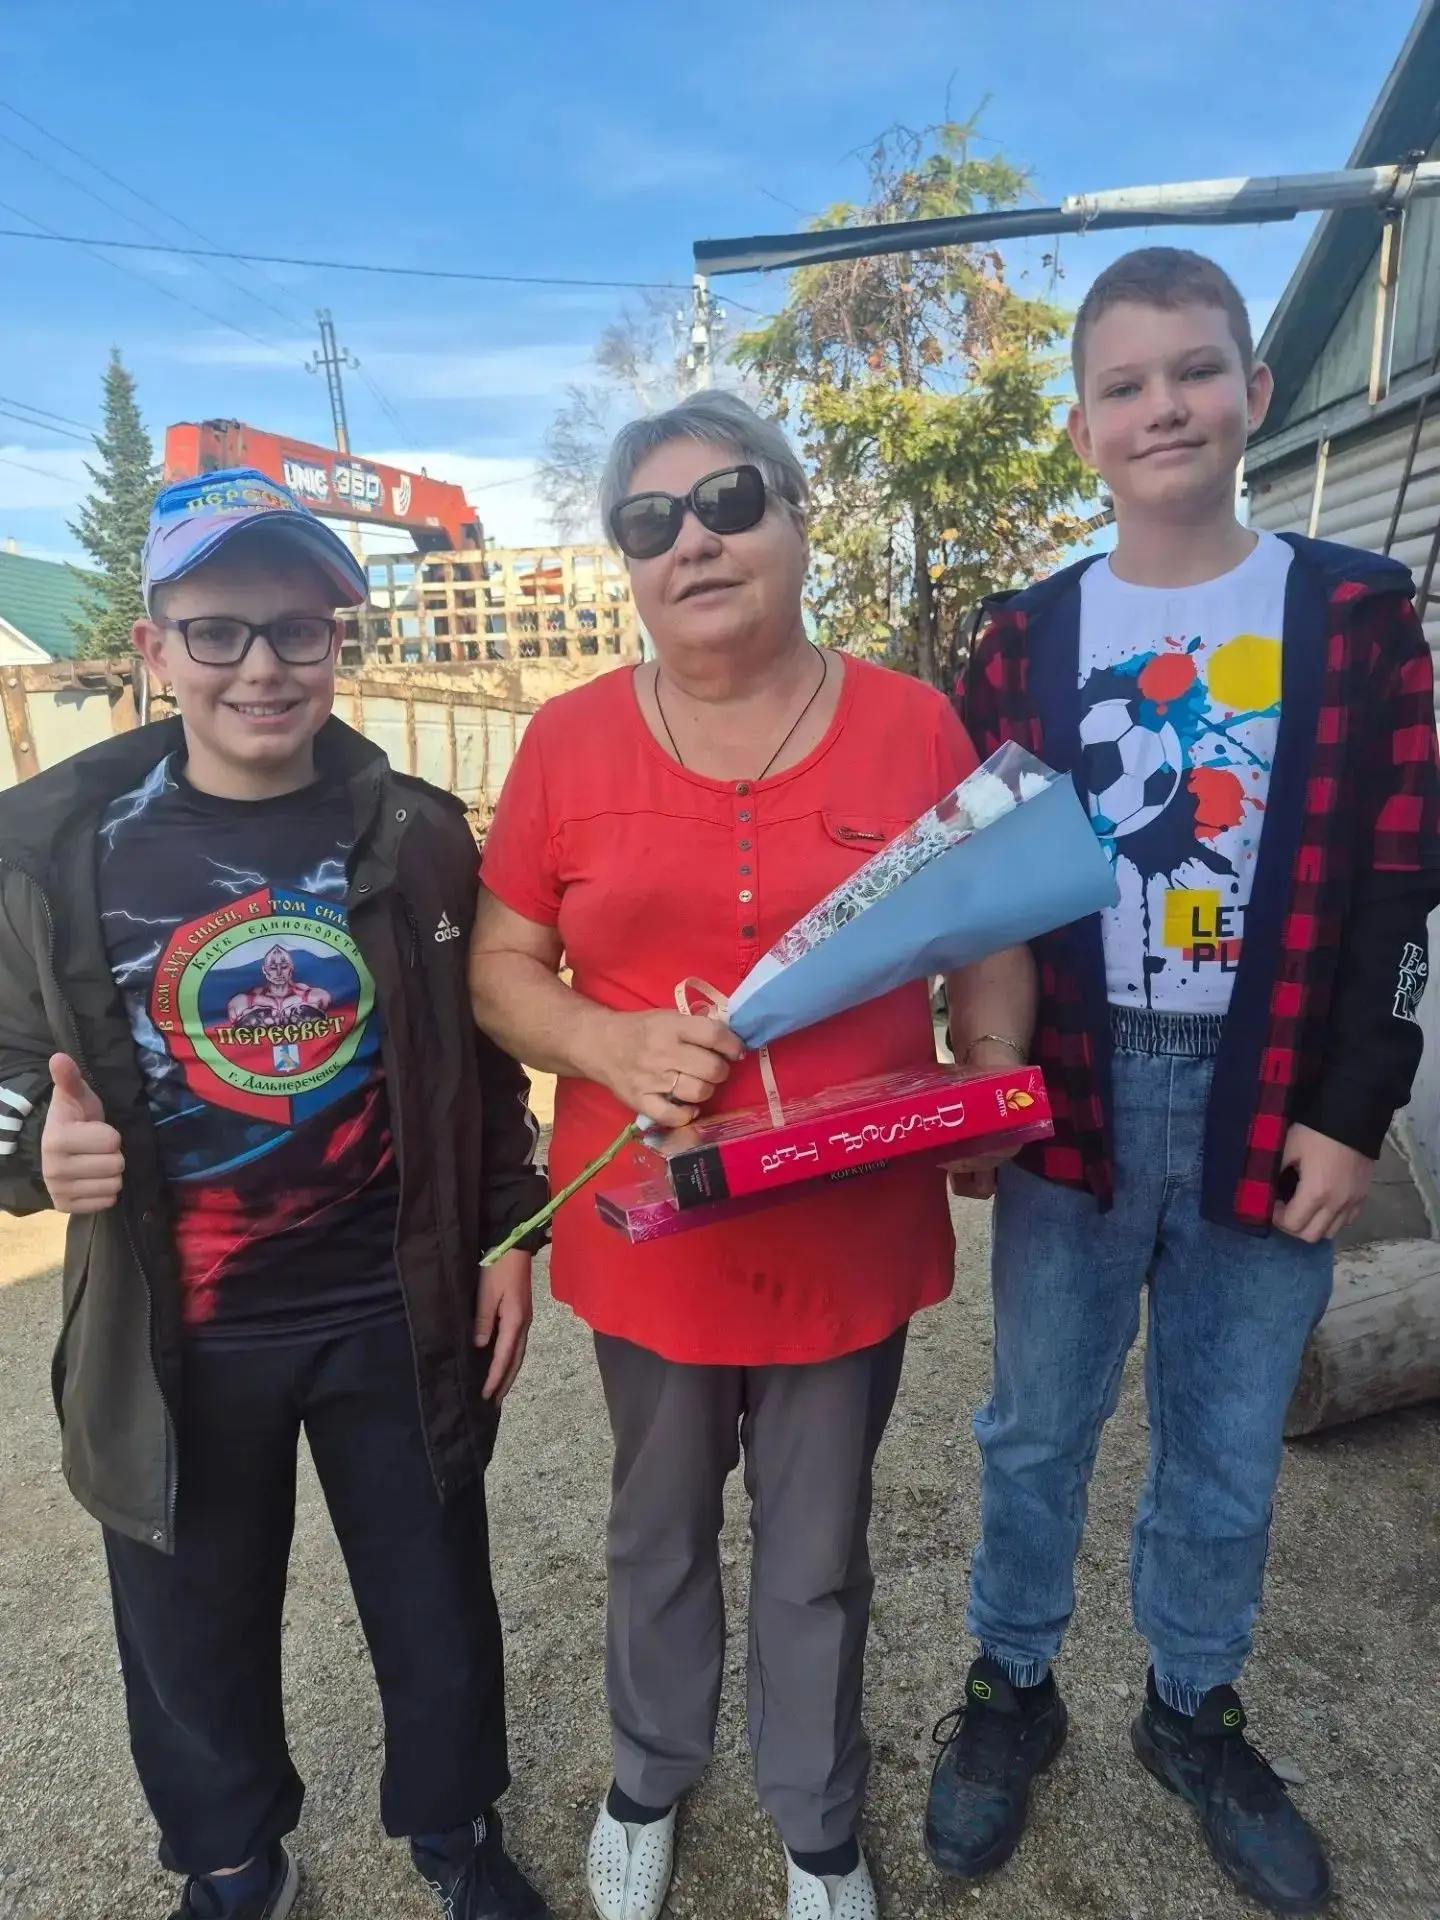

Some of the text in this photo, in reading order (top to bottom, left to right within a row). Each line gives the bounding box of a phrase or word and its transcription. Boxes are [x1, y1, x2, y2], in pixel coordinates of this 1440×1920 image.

[283, 461, 330, 498] UNIC
[214, 1016, 345, 1046] ПЕРЕСВЕТ
[995, 1088, 1008, 1118] CURTIS
